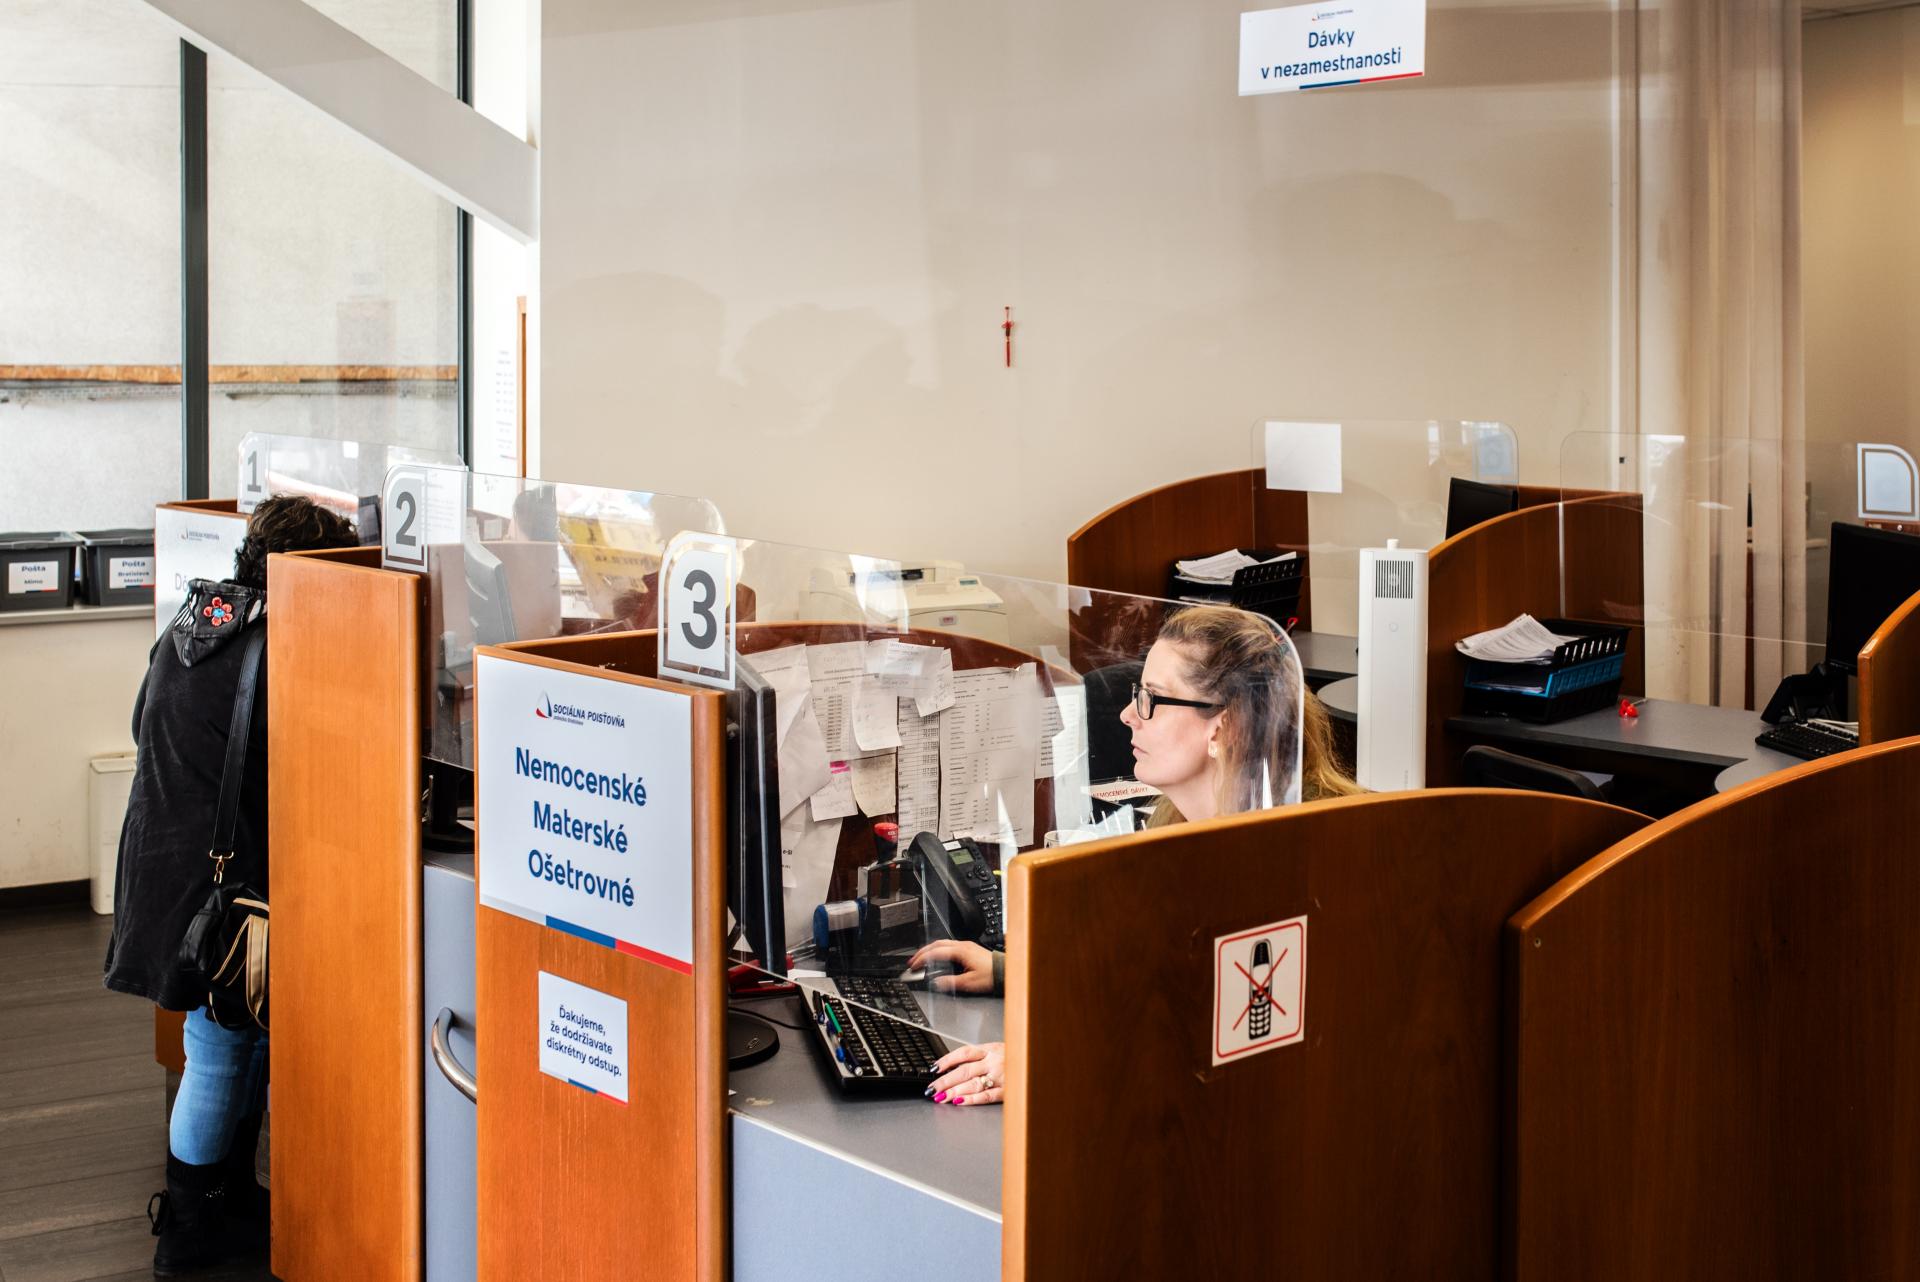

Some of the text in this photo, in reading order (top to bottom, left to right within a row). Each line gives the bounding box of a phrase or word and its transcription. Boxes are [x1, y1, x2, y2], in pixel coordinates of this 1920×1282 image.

[1308, 29, 1355, 48] Dávky
[1261, 46, 1401, 79] v nezamestnanosti
[247, 451, 262, 492] 1
[396, 491, 416, 547] 2
[21, 564, 46, 572] Pošta
[121, 560, 146, 568] Pošta
[681, 569, 718, 650] 3
[553, 703, 585, 719] SOCIÁLNA
[587, 711, 625, 729] POISŤOVŇA
[516, 746, 647, 807] Nemocenské
[533, 800, 628, 853] Materské
[528, 849, 634, 907] Ošetrovné
[550, 1020, 613, 1055] že dodržiavate
[559, 1004, 606, 1037] Ďakujeme,
[546, 1037, 622, 1077] diskrétny odstup.
